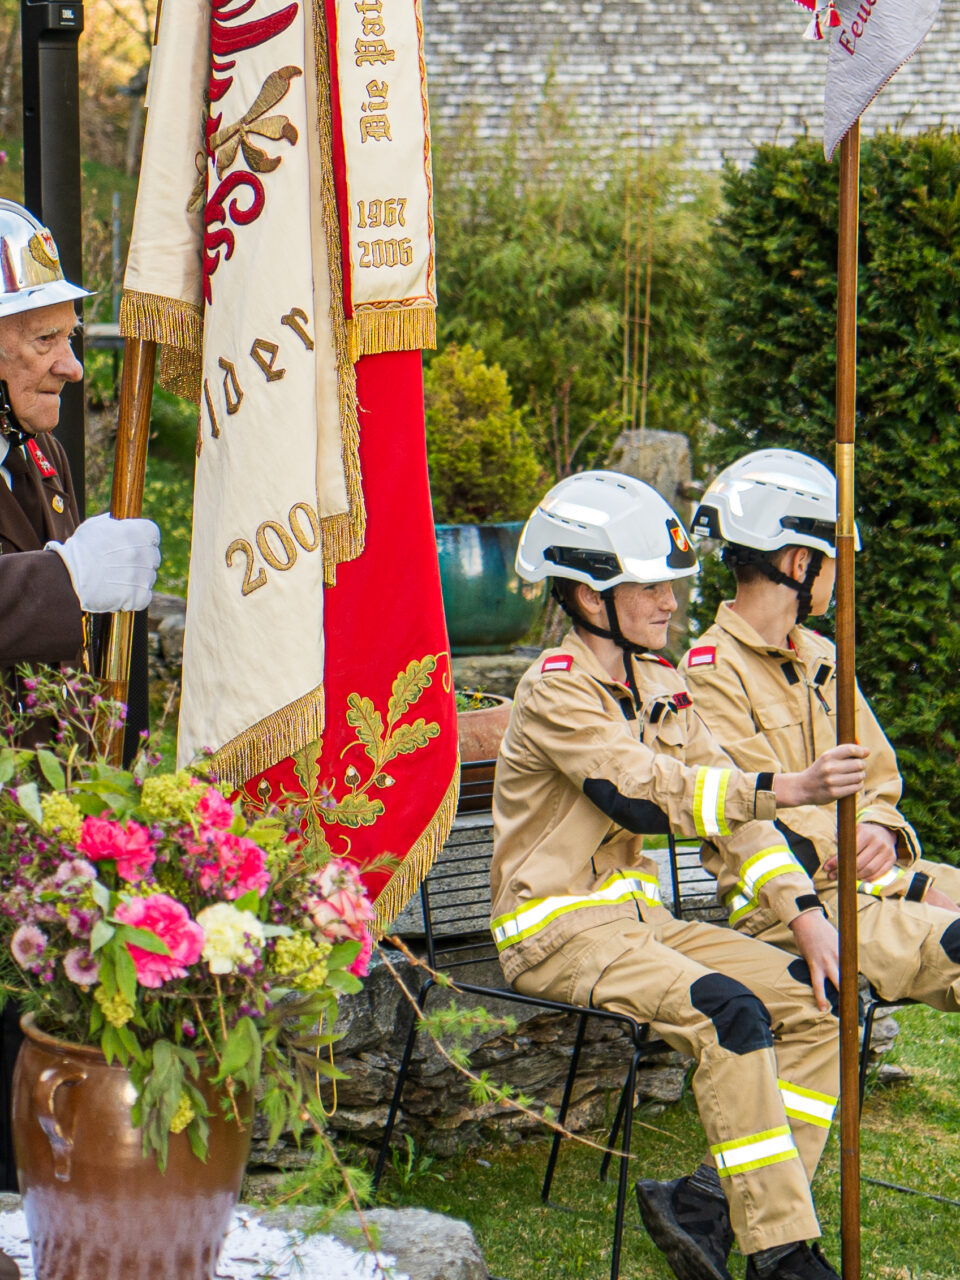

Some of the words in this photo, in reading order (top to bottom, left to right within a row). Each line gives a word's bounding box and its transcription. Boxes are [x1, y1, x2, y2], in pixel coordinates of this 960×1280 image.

[359, 79, 392, 145] Die
[357, 198, 408, 229] 1967
[357, 237, 413, 269] 2006
